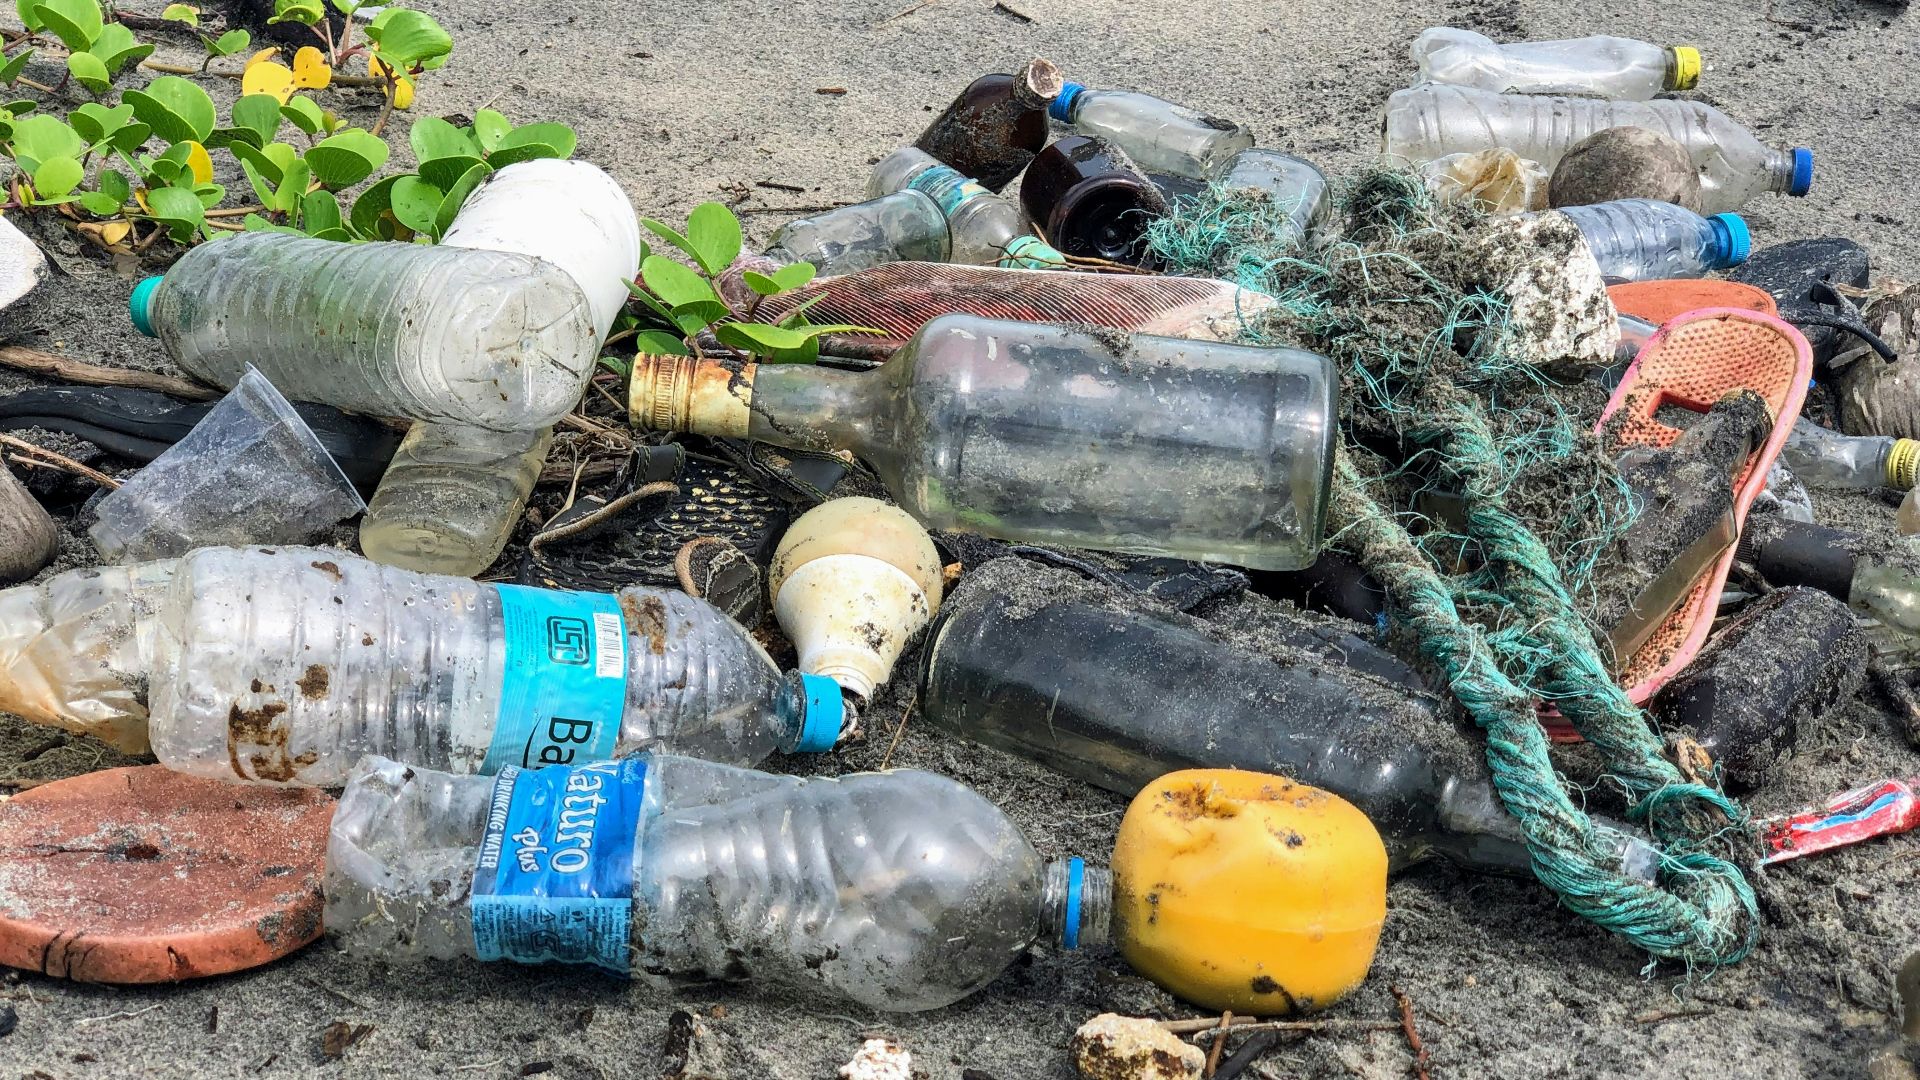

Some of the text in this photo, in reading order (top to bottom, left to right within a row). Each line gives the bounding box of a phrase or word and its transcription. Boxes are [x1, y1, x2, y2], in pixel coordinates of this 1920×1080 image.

[538, 717, 593, 769] Ba
[489, 778, 514, 831] DRINKING
[551, 761, 619, 874] Naturo
[481, 832, 504, 868] WATER
[512, 826, 548, 873] plus
